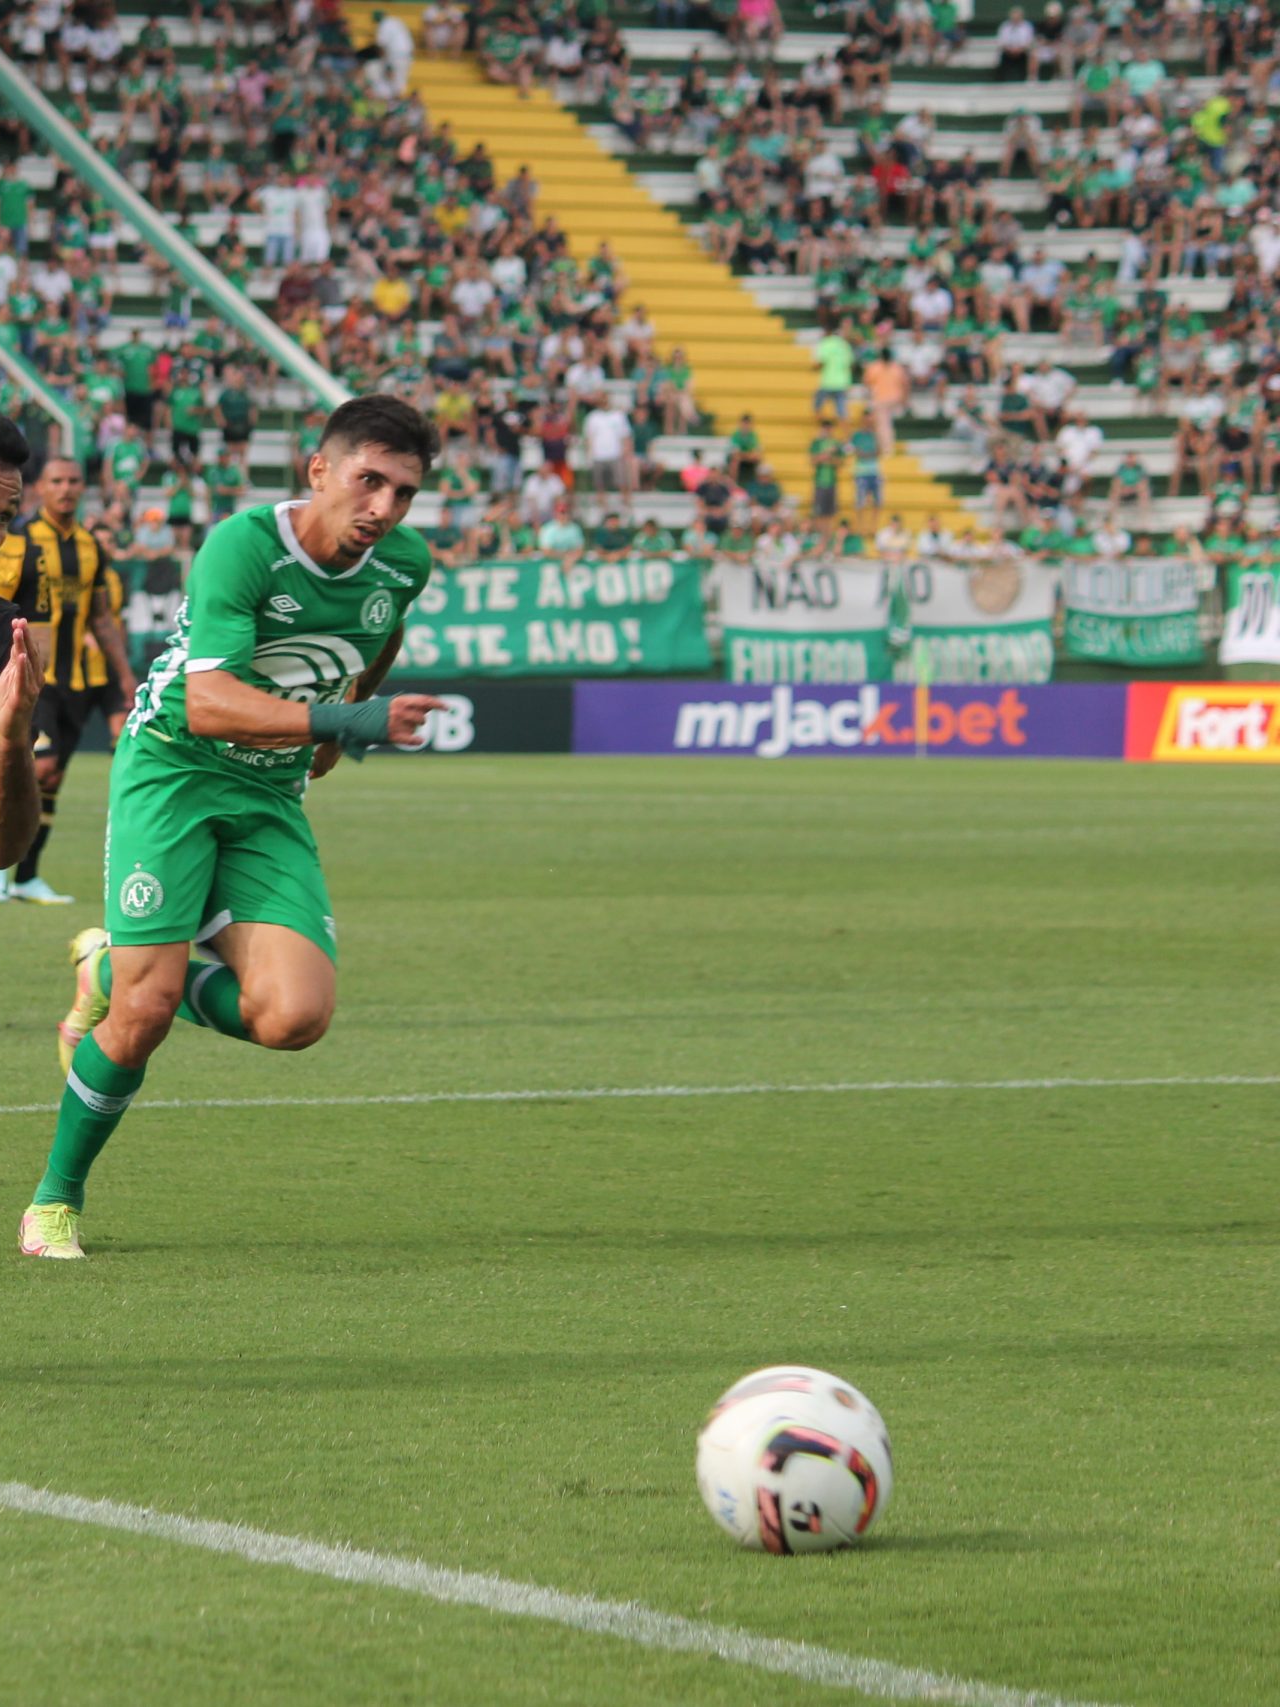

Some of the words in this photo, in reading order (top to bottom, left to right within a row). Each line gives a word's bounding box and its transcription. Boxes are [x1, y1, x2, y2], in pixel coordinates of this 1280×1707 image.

[456, 566, 519, 614] TE
[537, 560, 674, 609] APOIO
[443, 624, 511, 667] TE
[526, 618, 643, 666] AMO!
[1177, 698, 1270, 751] Fort
